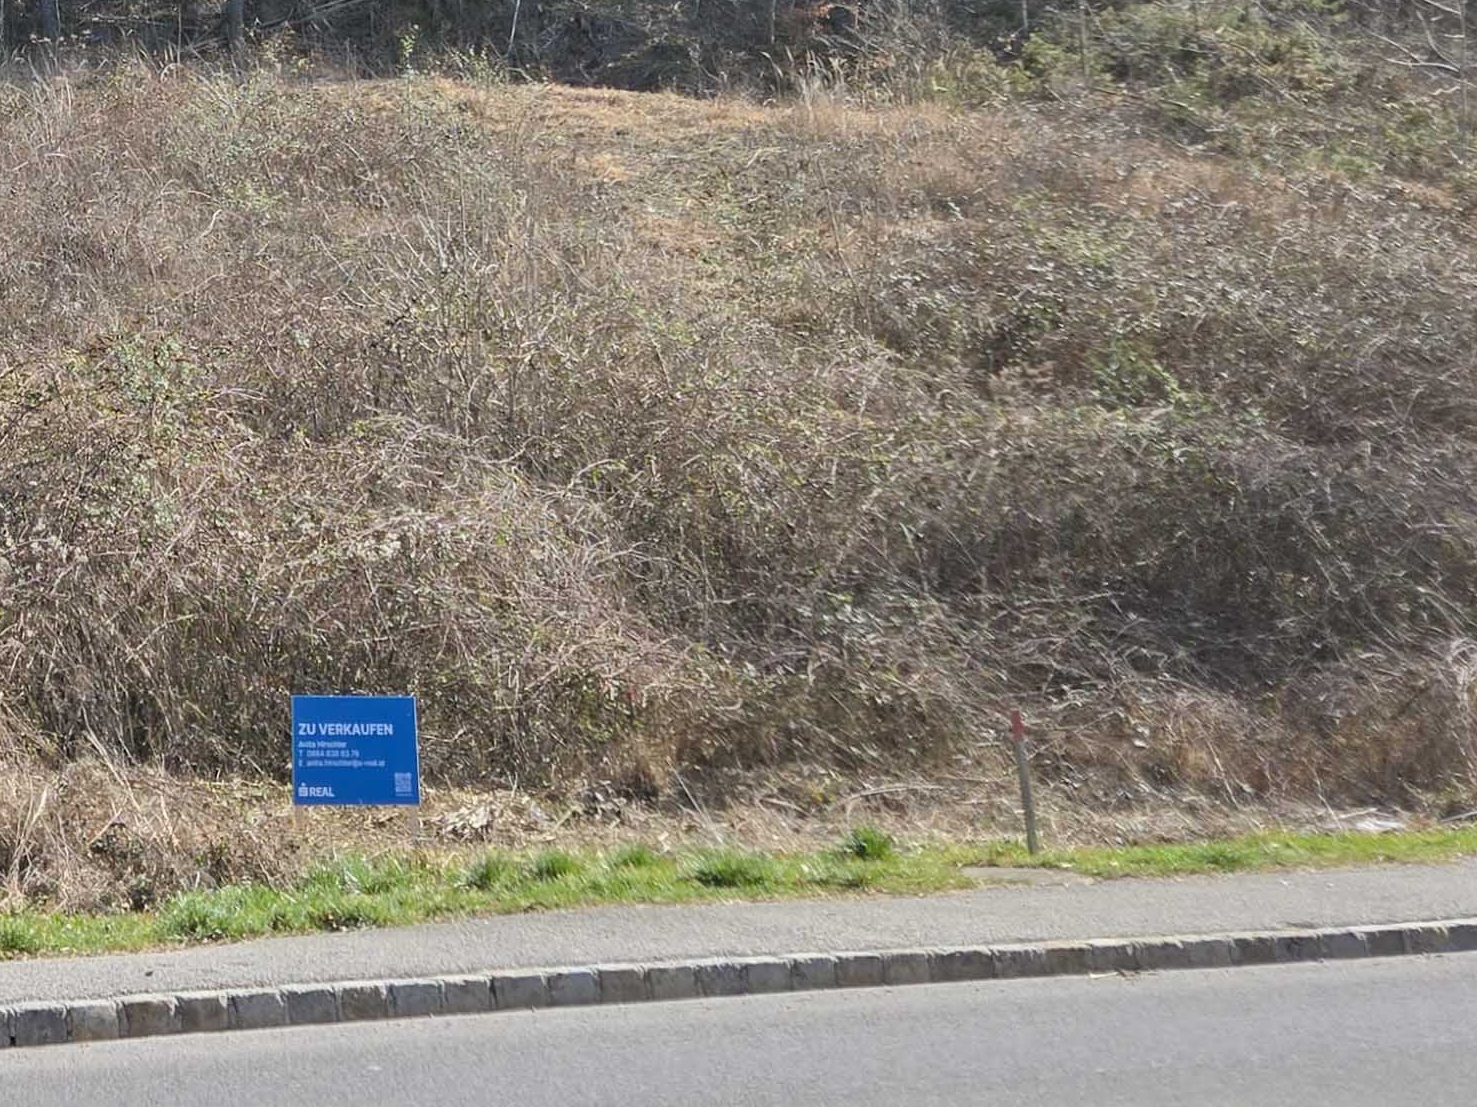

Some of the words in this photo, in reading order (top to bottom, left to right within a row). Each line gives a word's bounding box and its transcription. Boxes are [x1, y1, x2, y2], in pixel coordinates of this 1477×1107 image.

[298, 723, 316, 735] ZU
[319, 723, 394, 735] VERKAUFEN
[309, 786, 335, 797] REAL
